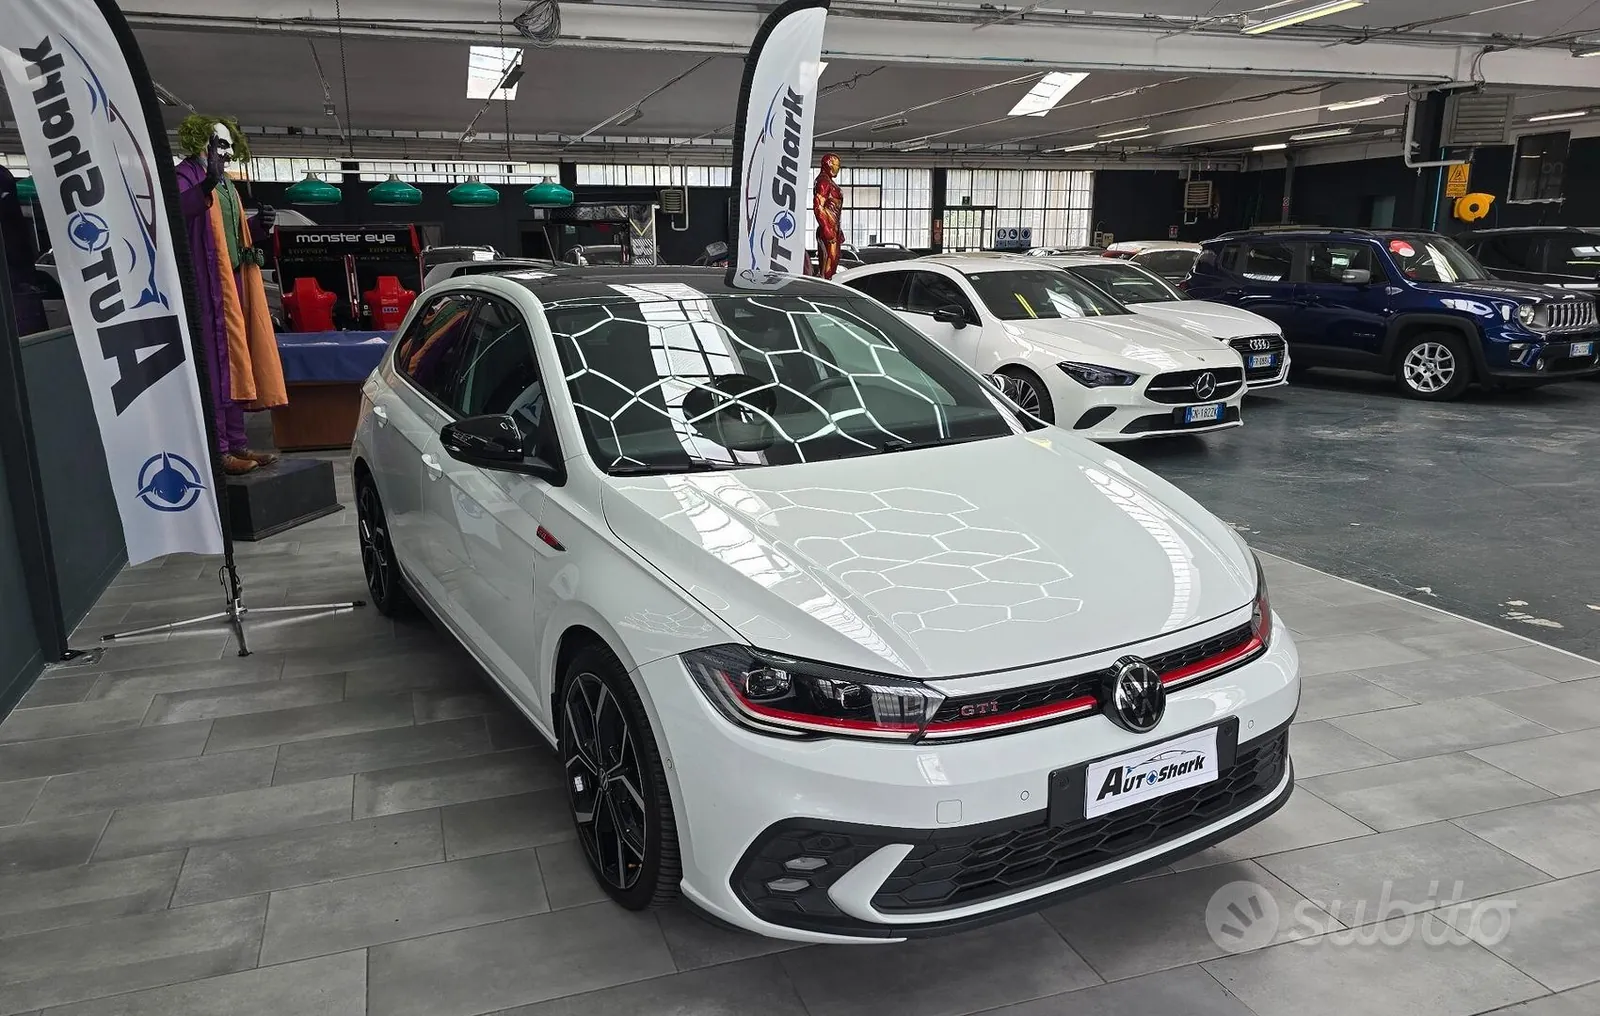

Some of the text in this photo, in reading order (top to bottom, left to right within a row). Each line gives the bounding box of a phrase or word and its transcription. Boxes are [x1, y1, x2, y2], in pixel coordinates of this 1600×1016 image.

[296, 233, 396, 244] monster eye
[960, 701, 999, 718] GTI
